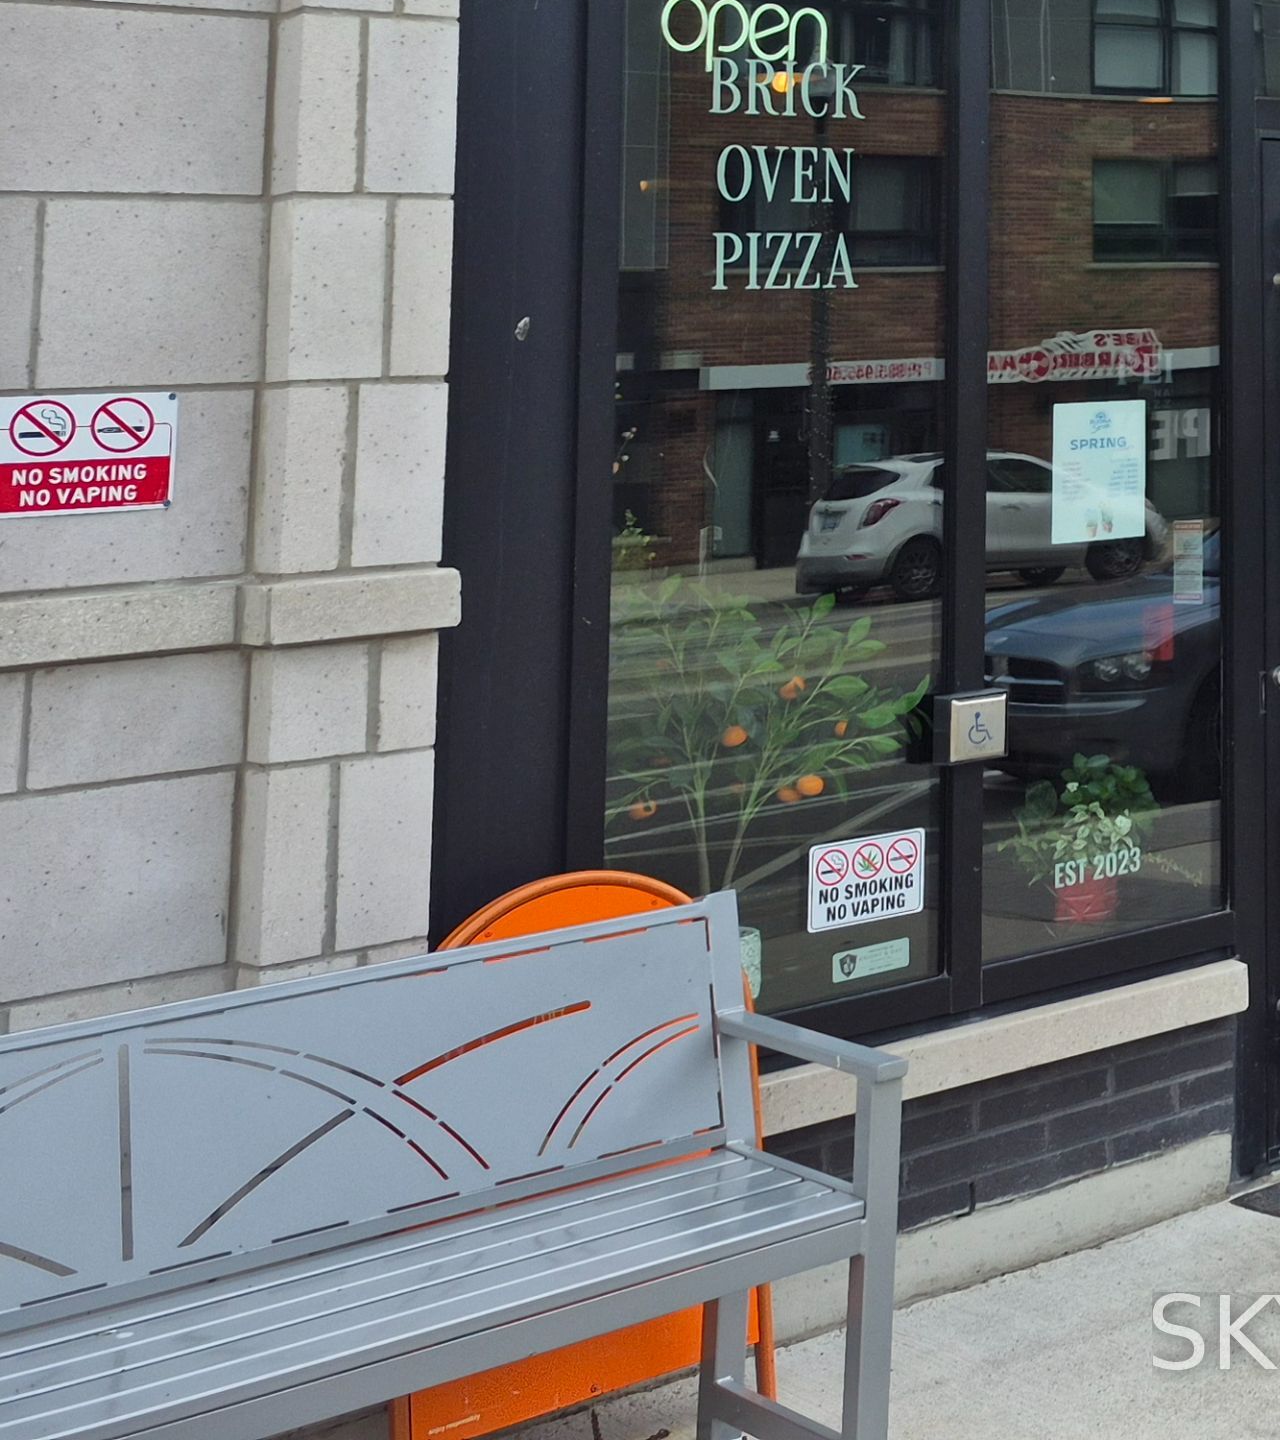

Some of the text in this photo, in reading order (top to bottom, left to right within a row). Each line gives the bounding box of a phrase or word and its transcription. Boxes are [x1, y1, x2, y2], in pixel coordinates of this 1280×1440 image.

[708, 58, 866, 121] BRICK
[716, 144, 855, 205] OVEN
[711, 231, 859, 291] PIZZA
[1070, 436, 1128, 451] SPRING
[11, 463, 148, 486] NO SMOKING
[19, 484, 138, 507] NO VAPING
[1054, 846, 1141, 889] EST 2023
[819, 872, 914, 905] NO SMOKING
[826, 892, 906, 922] NO VAPING
